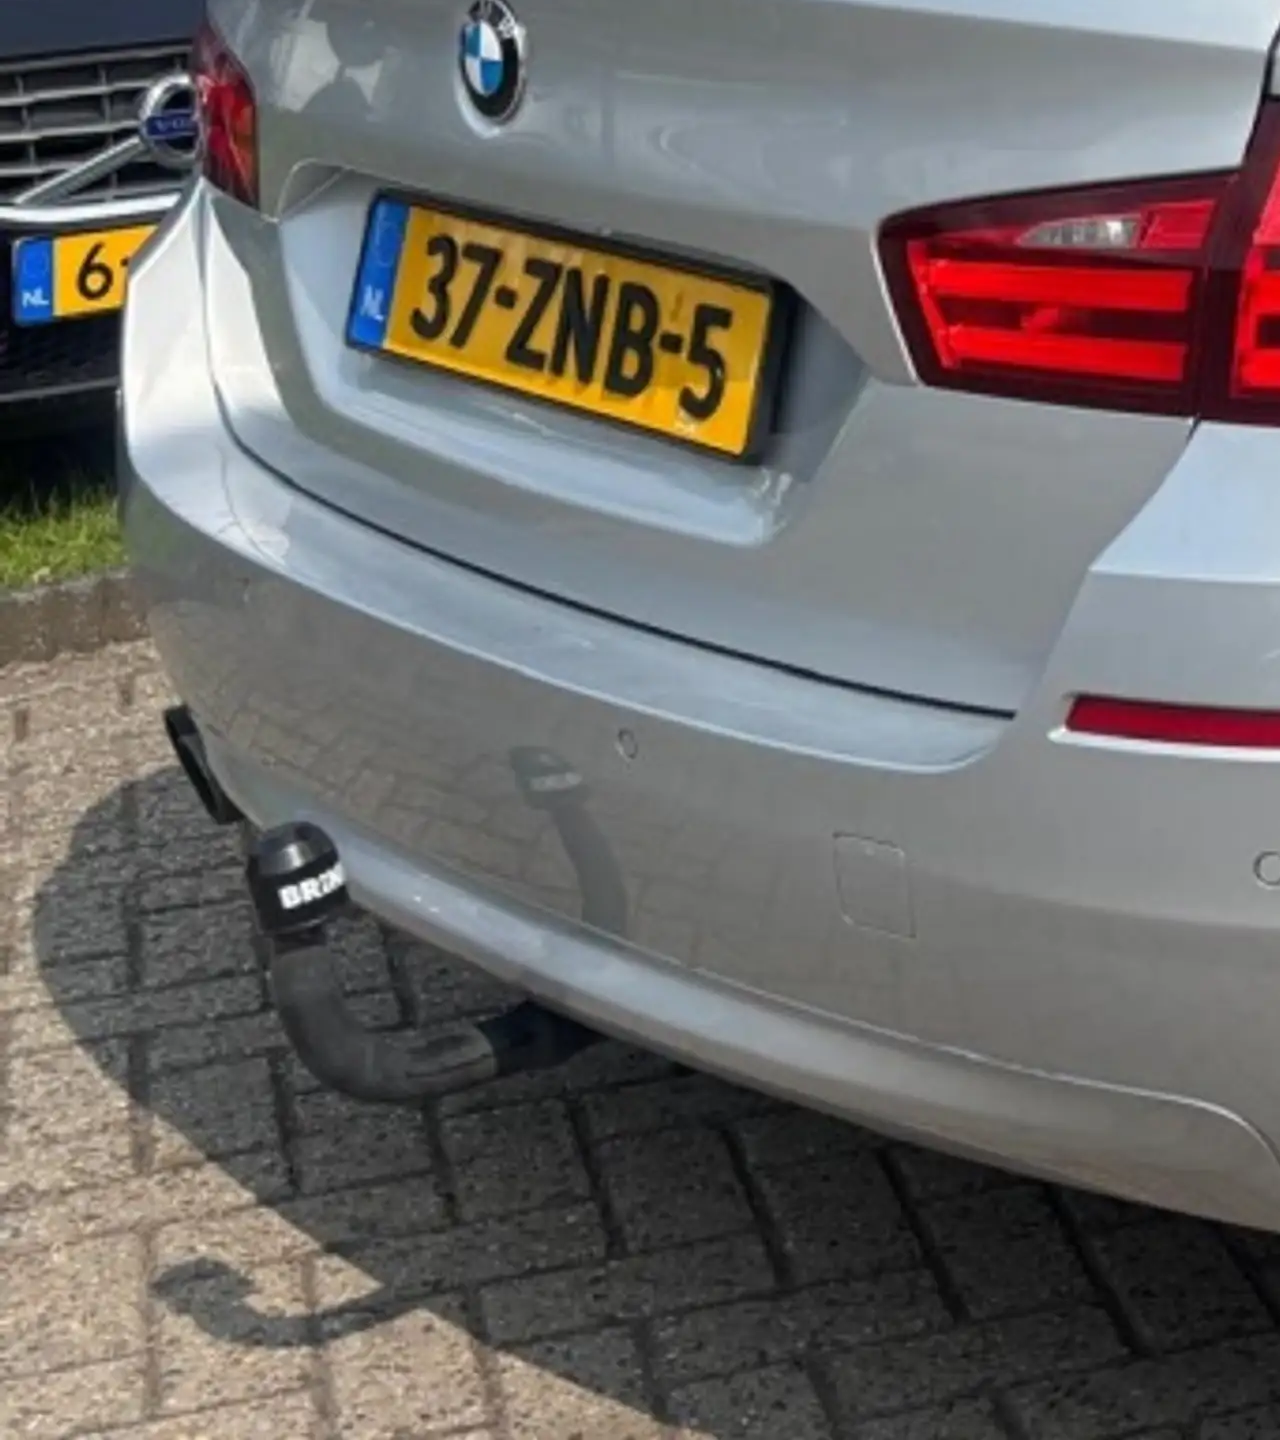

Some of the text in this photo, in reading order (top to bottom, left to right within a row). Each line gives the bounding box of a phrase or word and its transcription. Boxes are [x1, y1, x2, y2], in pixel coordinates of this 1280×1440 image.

[22, 287, 49, 308] NL
[359, 283, 385, 322] NL
[408, 232, 733, 423] 37-ZNB-5
